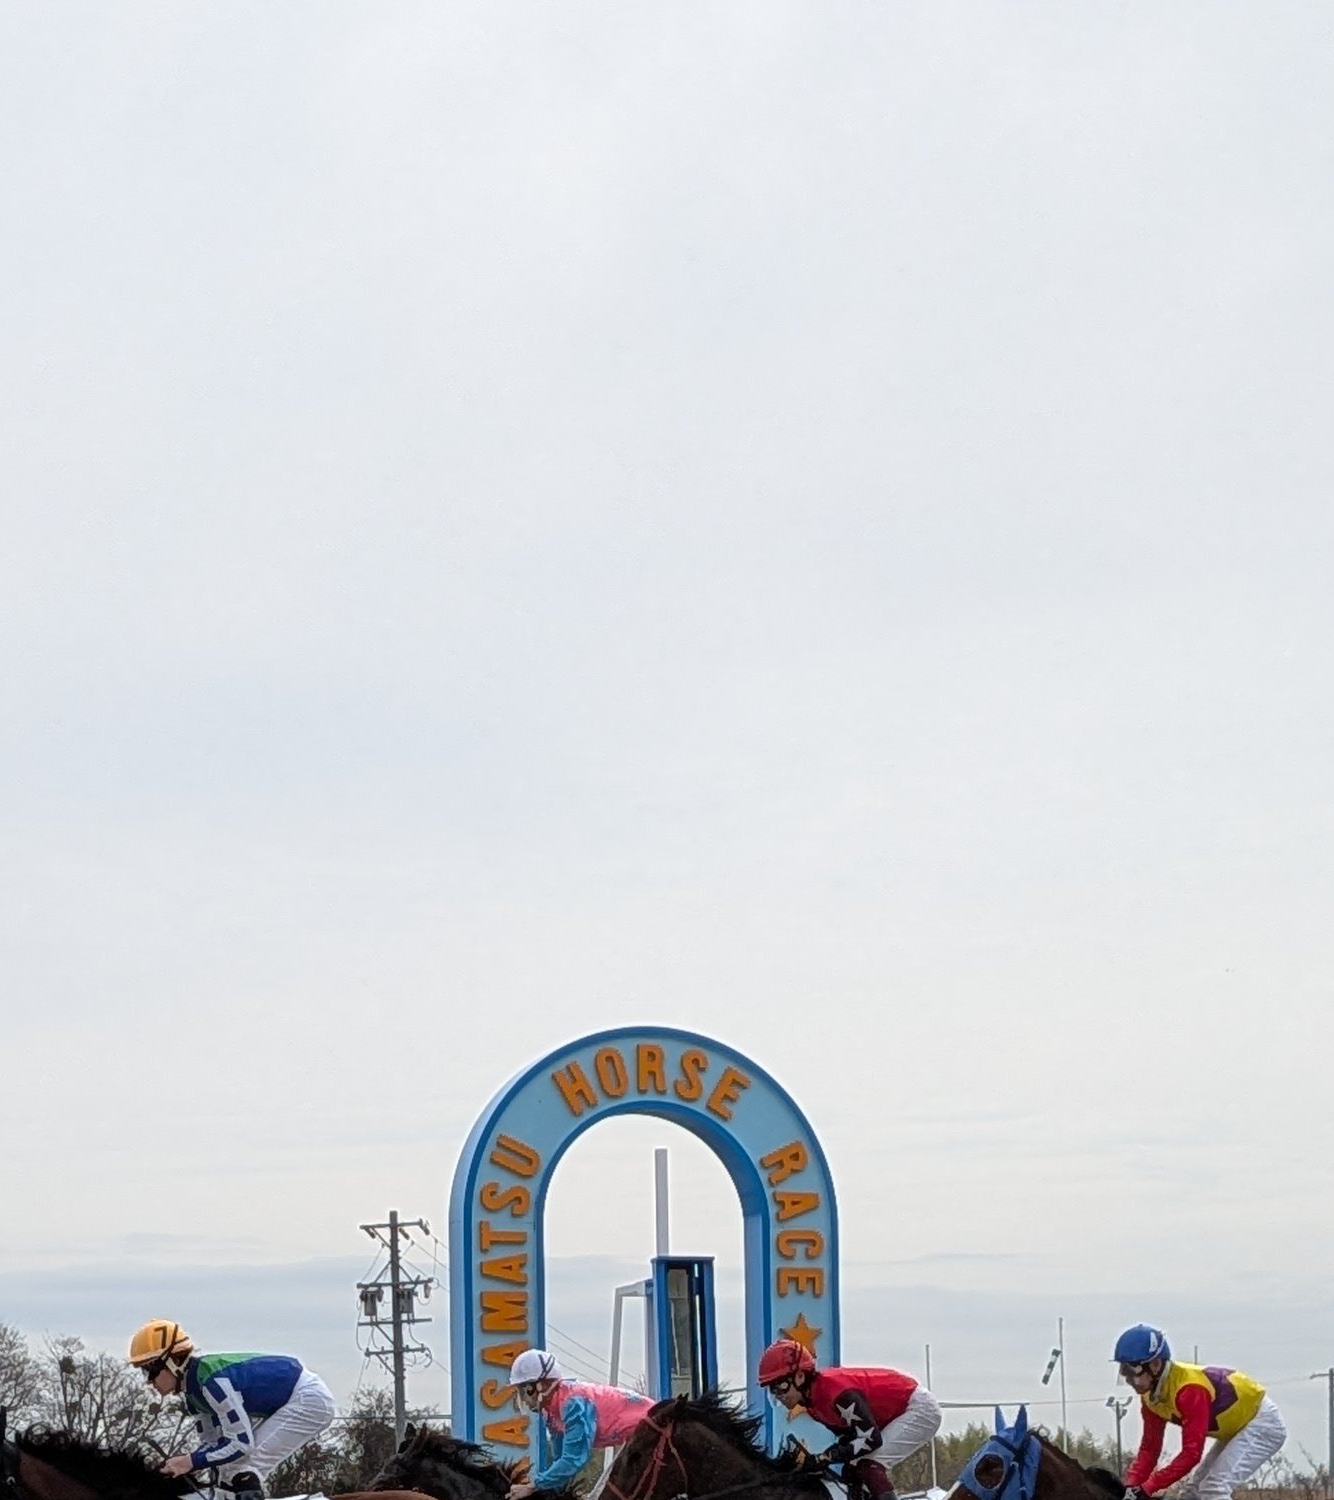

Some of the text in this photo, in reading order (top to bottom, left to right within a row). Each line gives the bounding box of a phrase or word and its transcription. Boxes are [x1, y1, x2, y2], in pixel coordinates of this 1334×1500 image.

[552, 1043, 751, 1121] HORSE
[760, 1140, 825, 1298] RACE
[154, 1325, 167, 1349] 7
